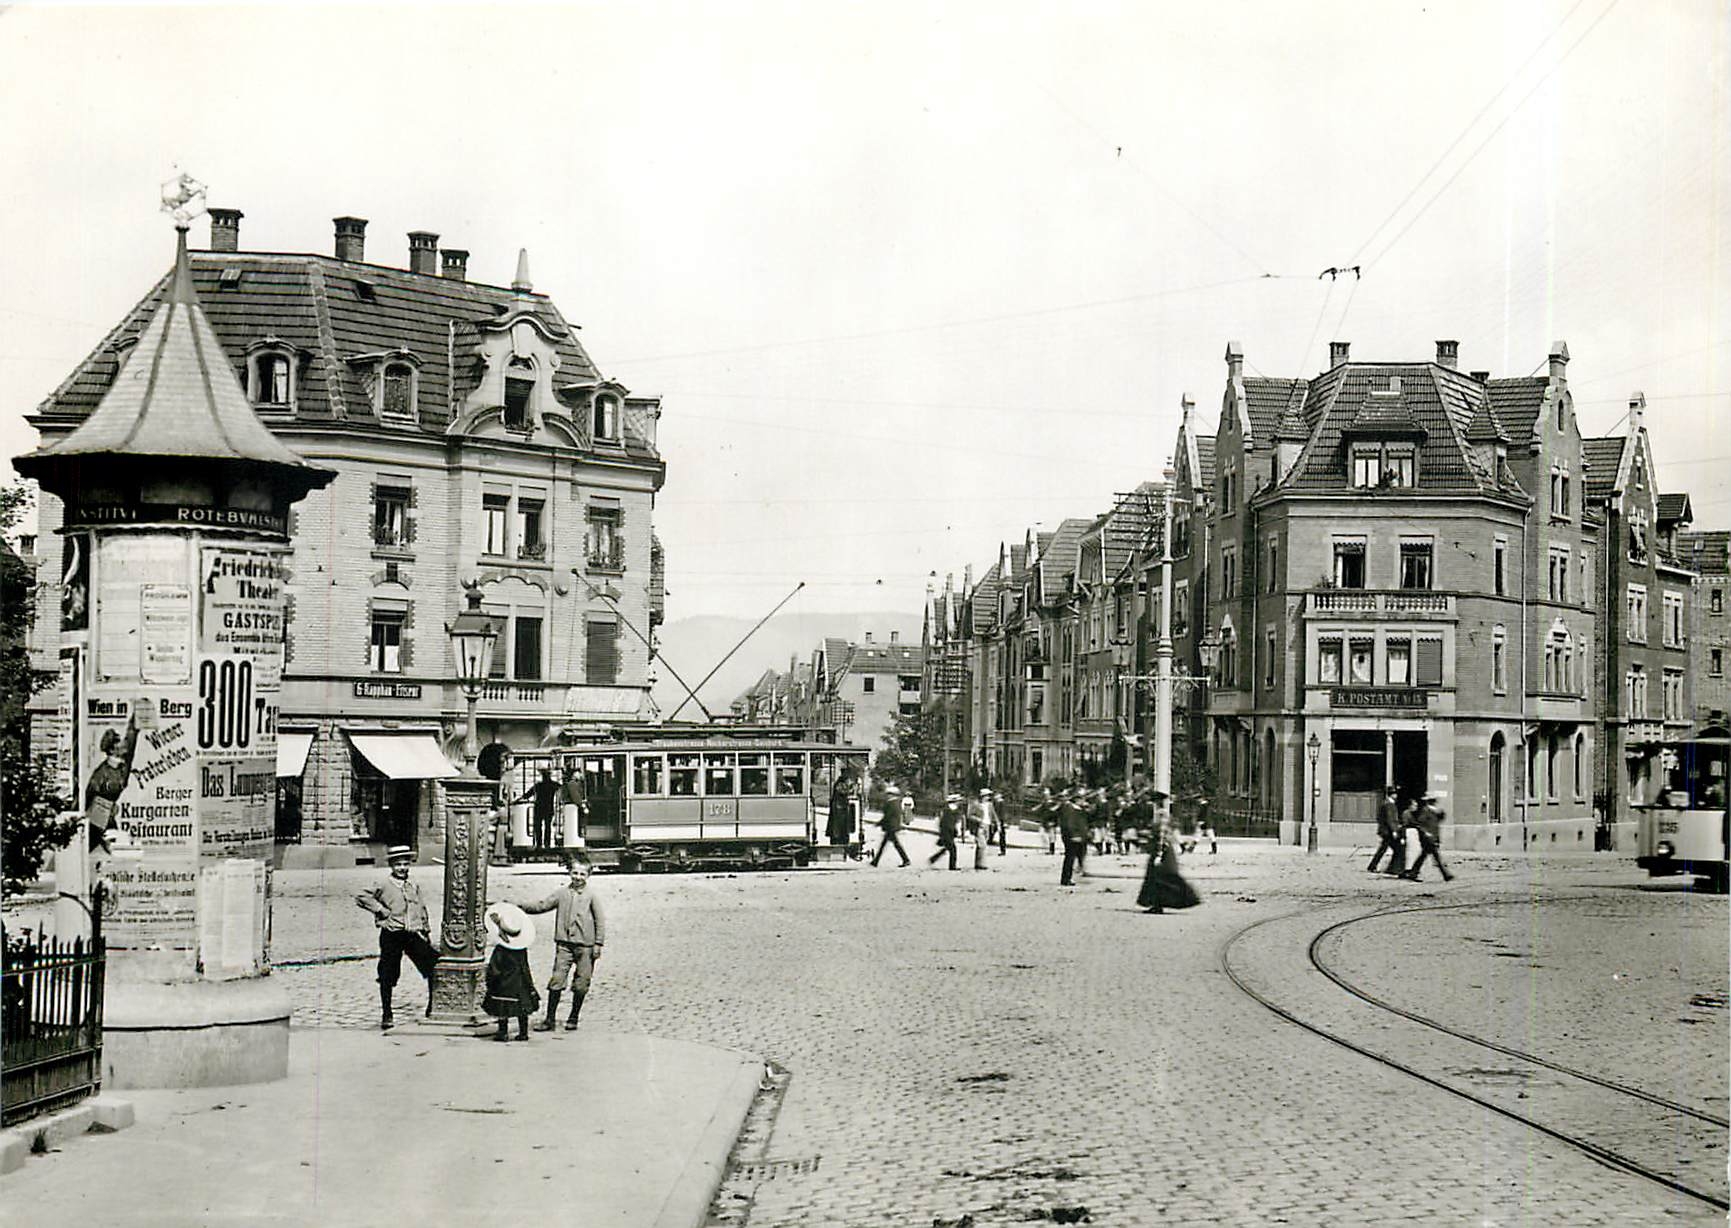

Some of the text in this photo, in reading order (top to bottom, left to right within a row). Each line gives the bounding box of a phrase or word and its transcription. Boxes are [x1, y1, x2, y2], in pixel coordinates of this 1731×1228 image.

[87, 698, 192, 719] Wien in Berg
[198, 660, 252, 748] 300
[1350, 693, 1399, 704] POSTAMT
[145, 722, 184, 750] Wiener
[156, 786, 193, 800] Berger
[201, 766, 224, 797] Das
